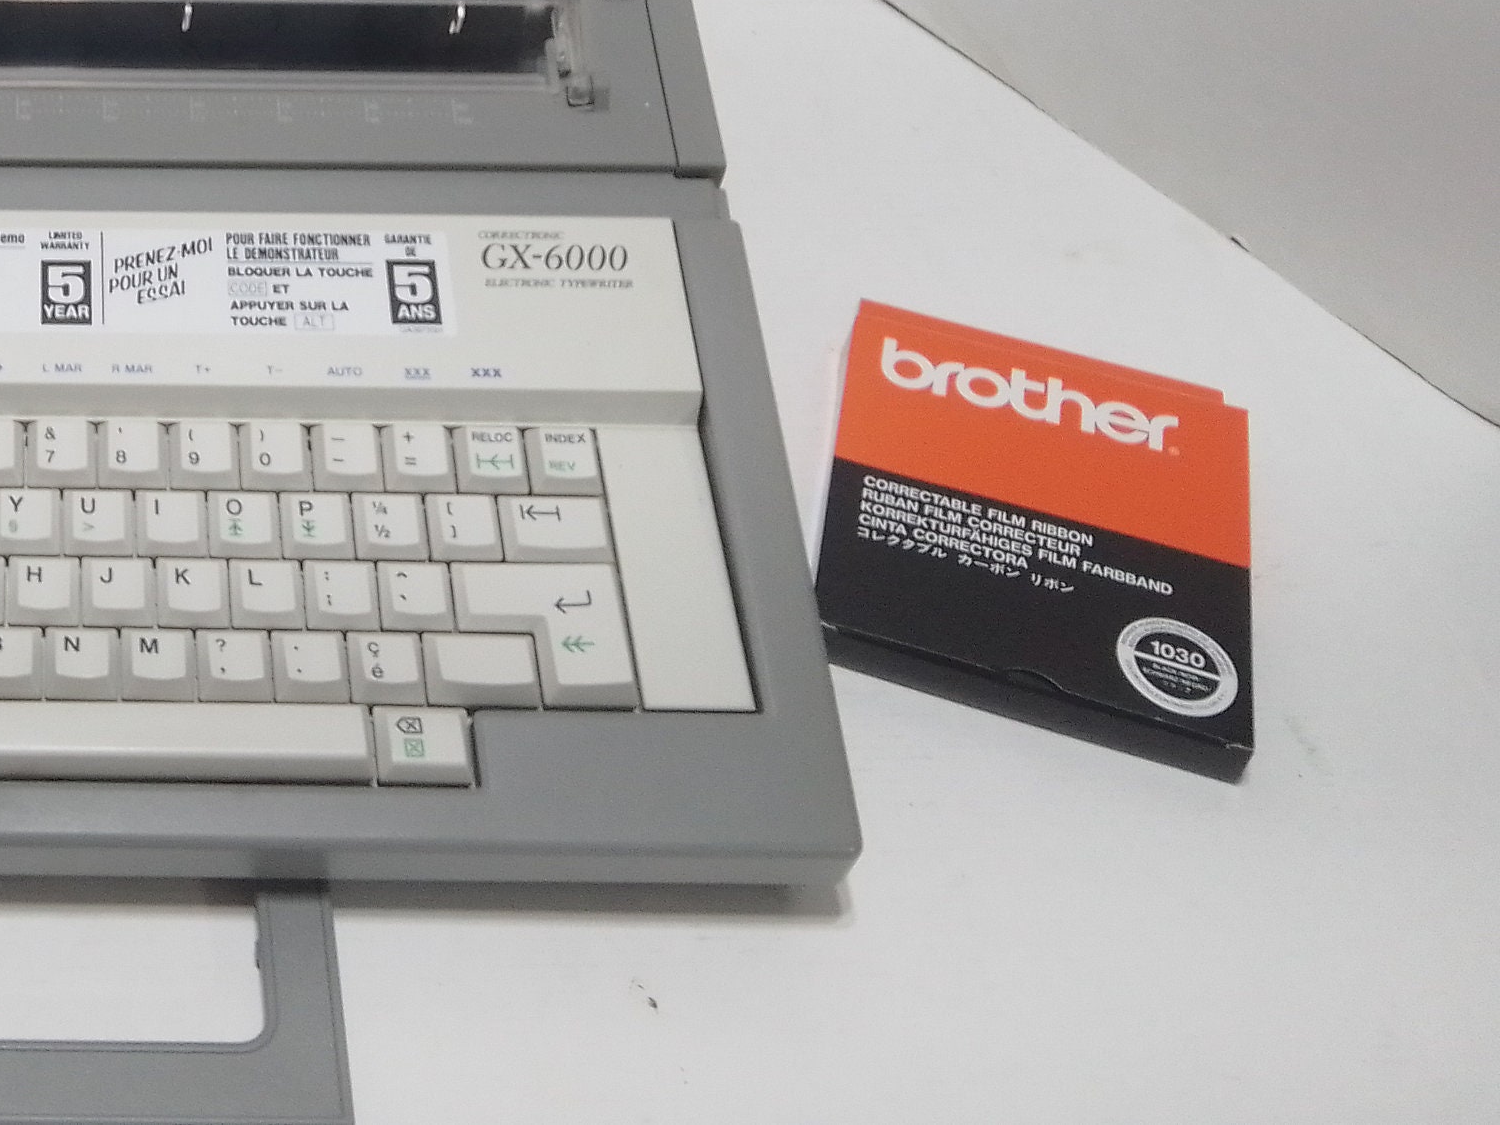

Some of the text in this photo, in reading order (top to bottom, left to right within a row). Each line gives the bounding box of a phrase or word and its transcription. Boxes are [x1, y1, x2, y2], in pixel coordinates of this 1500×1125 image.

[226, 233, 371, 246] POUR FAIRE FONCTIONNER
[384, 234, 431, 245] GARANTIE
[478, 231, 564, 240] CORRECTRONIC
[41, 242, 89, 250] WARRANTY
[226, 248, 240, 259] LE
[114, 237, 213, 273] PRENEZ-MOI
[482, 243, 629, 271] GX-6000
[109, 264, 178, 293] POUR UN
[228, 267, 373, 278] BLOQUER LA TOUCHE
[48, 264, 85, 303] 5
[229, 283, 289, 295] CODE ET
[394, 264, 434, 303] 5
[485, 279, 633, 289] ELECTRONIC TYPEWRITER
[138, 282, 185, 304] ESSAI
[44, 304, 89, 319] YEAR
[231, 301, 349, 311] APPUYER SUR LA
[398, 305, 437, 321] ANS
[231, 316, 287, 326] TOUCHE
[55, 364, 82, 373] MAR
[125, 364, 153, 373] MAR
[327, 366, 362, 376] AUTO
[471, 367, 501, 377] XXX
[881, 337, 1179, 452] brother
[45, 427, 56, 440] &
[472, 432, 513, 443] RELOC
[545, 433, 586, 443] INDEX
[45, 450, 55, 463] 7
[115, 449, 127, 464] 8
[188, 452, 199, 465] 9
[259, 453, 271, 466] 0
[549, 460, 575, 471] REV
[9, 496, 23, 512] Y
[81, 498, 96, 513] U
[154, 500, 159, 515] I
[226, 499, 242, 515] O
[300, 501, 313, 516] P
[864, 475, 1095, 547] CORRECTABLE FILM RIBBON
[862, 488, 1081, 557] RUBAN FILM CORRECTEUR
[858, 514, 1028, 570] CINTA CORRECTORA
[860, 500, 1174, 596] KORREKTURFÄHIGES FILM FARBBAND
[856, 527, 1075, 594] コレクタブル カーボン リボン
[27, 566, 42, 583] H
[100, 567, 113, 583] J
[175, 568, 190, 585] K
[248, 569, 262, 586] L
[64, 636, 80, 652] N
[140, 638, 159, 654] M
[1150, 640, 1206, 669] 1030
